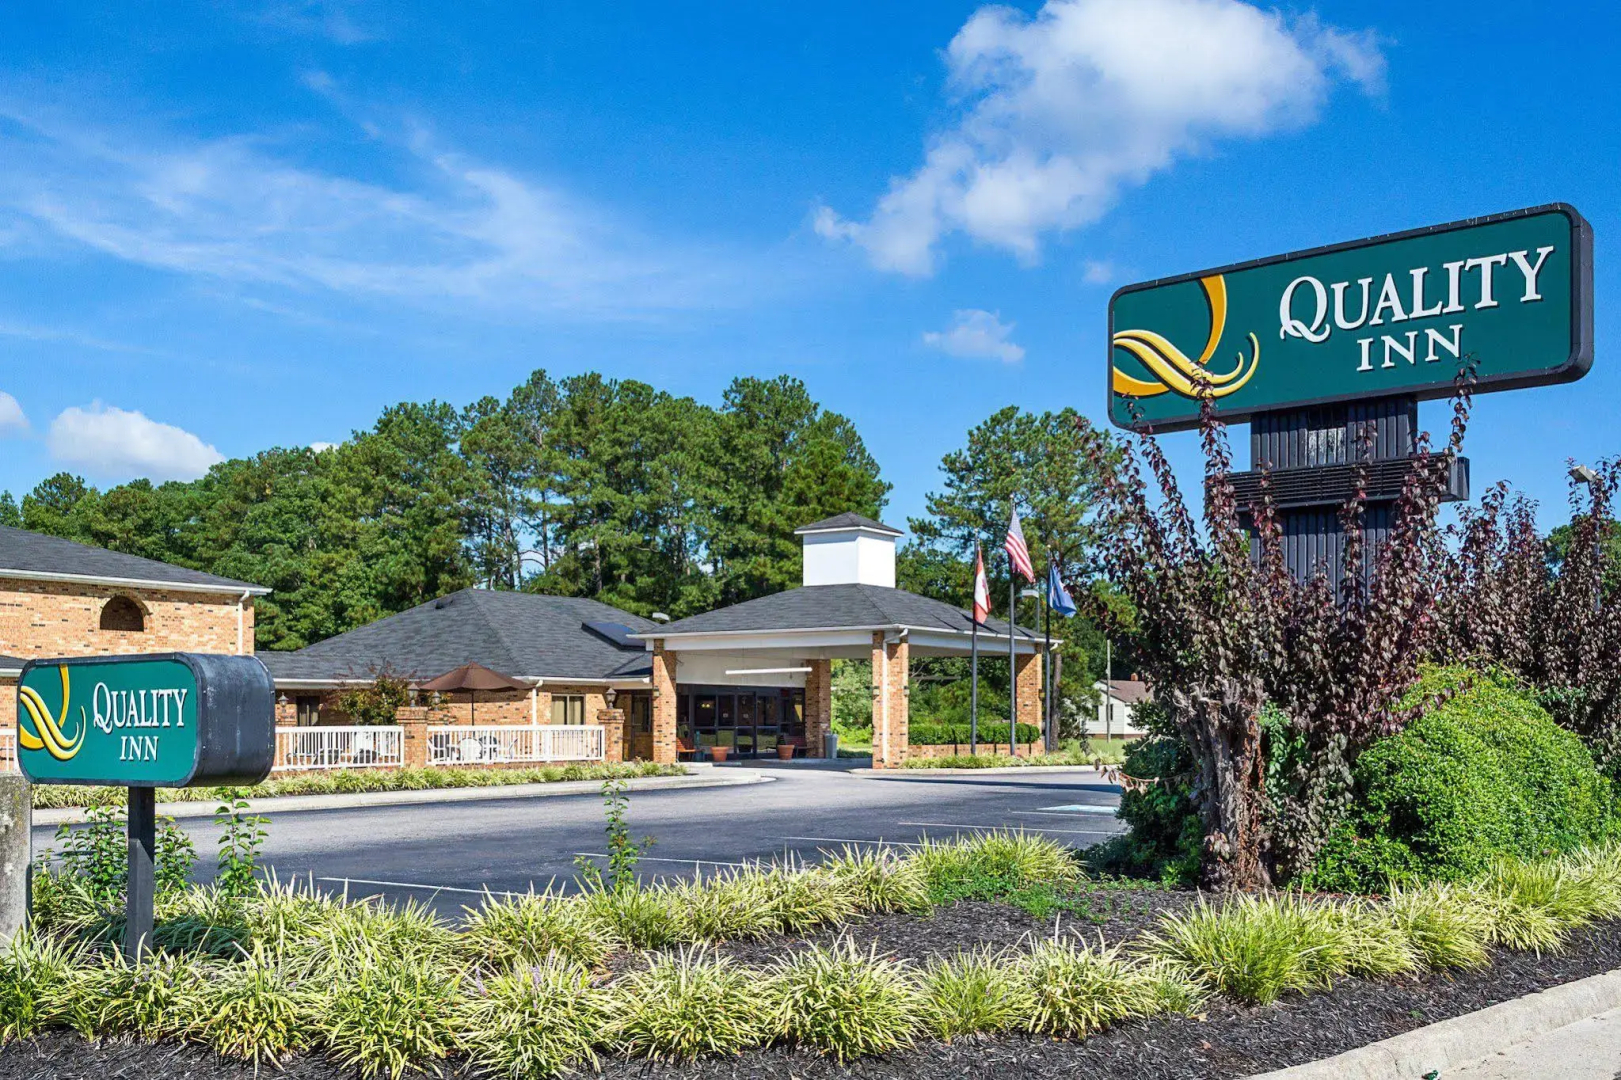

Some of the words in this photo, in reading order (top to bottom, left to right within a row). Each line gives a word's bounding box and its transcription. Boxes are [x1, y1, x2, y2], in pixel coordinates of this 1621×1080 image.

[1279, 245, 1555, 343] QUALITY
[1356, 324, 1463, 371] INN
[92, 681, 188, 735] QUALITY
[119, 735, 159, 761] INN
